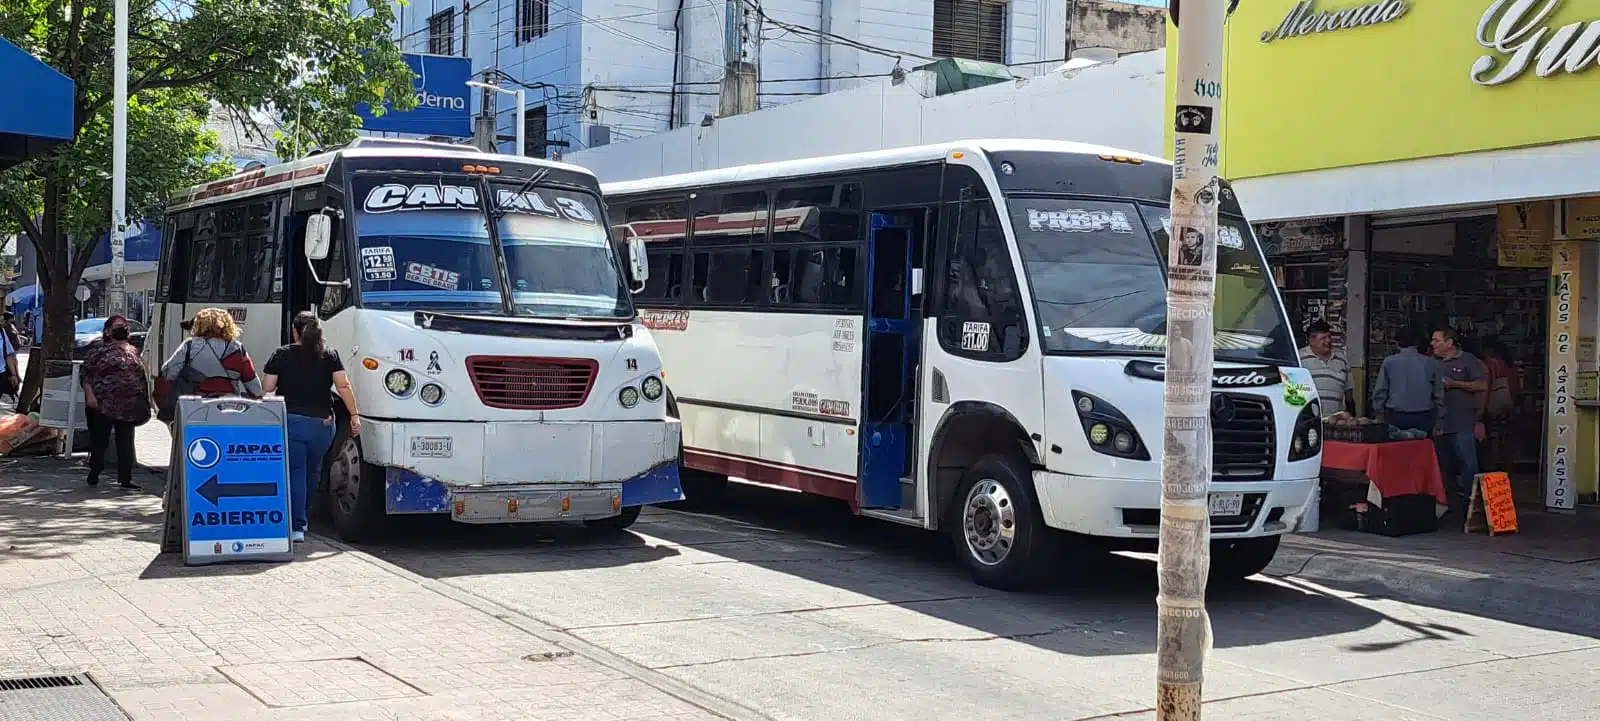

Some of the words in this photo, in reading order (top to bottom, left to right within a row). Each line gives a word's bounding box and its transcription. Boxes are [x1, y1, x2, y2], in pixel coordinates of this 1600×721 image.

[1260, 0, 1408, 43] Mercado
[1469, 0, 1600, 86] Gu
[416, 90, 465, 110] derna
[1026, 209, 1134, 234] PREPA
[364, 247, 391, 255] TARIFA
[409, 262, 459, 283] CBTIS
[1558, 272, 1571, 322] TACOS
[964, 323, 988, 333] TARIFA
[963, 332, 988, 349] $11.00
[1558, 334, 1569, 353] DE
[399, 349, 413, 361] 14
[626, 358, 638, 370] 14
[1556, 364, 1568, 415] ASADA
[225, 444, 282, 454] JAPAC
[1555, 447, 1567, 507] PASTOR
[192, 510, 283, 526] ABIERTO
